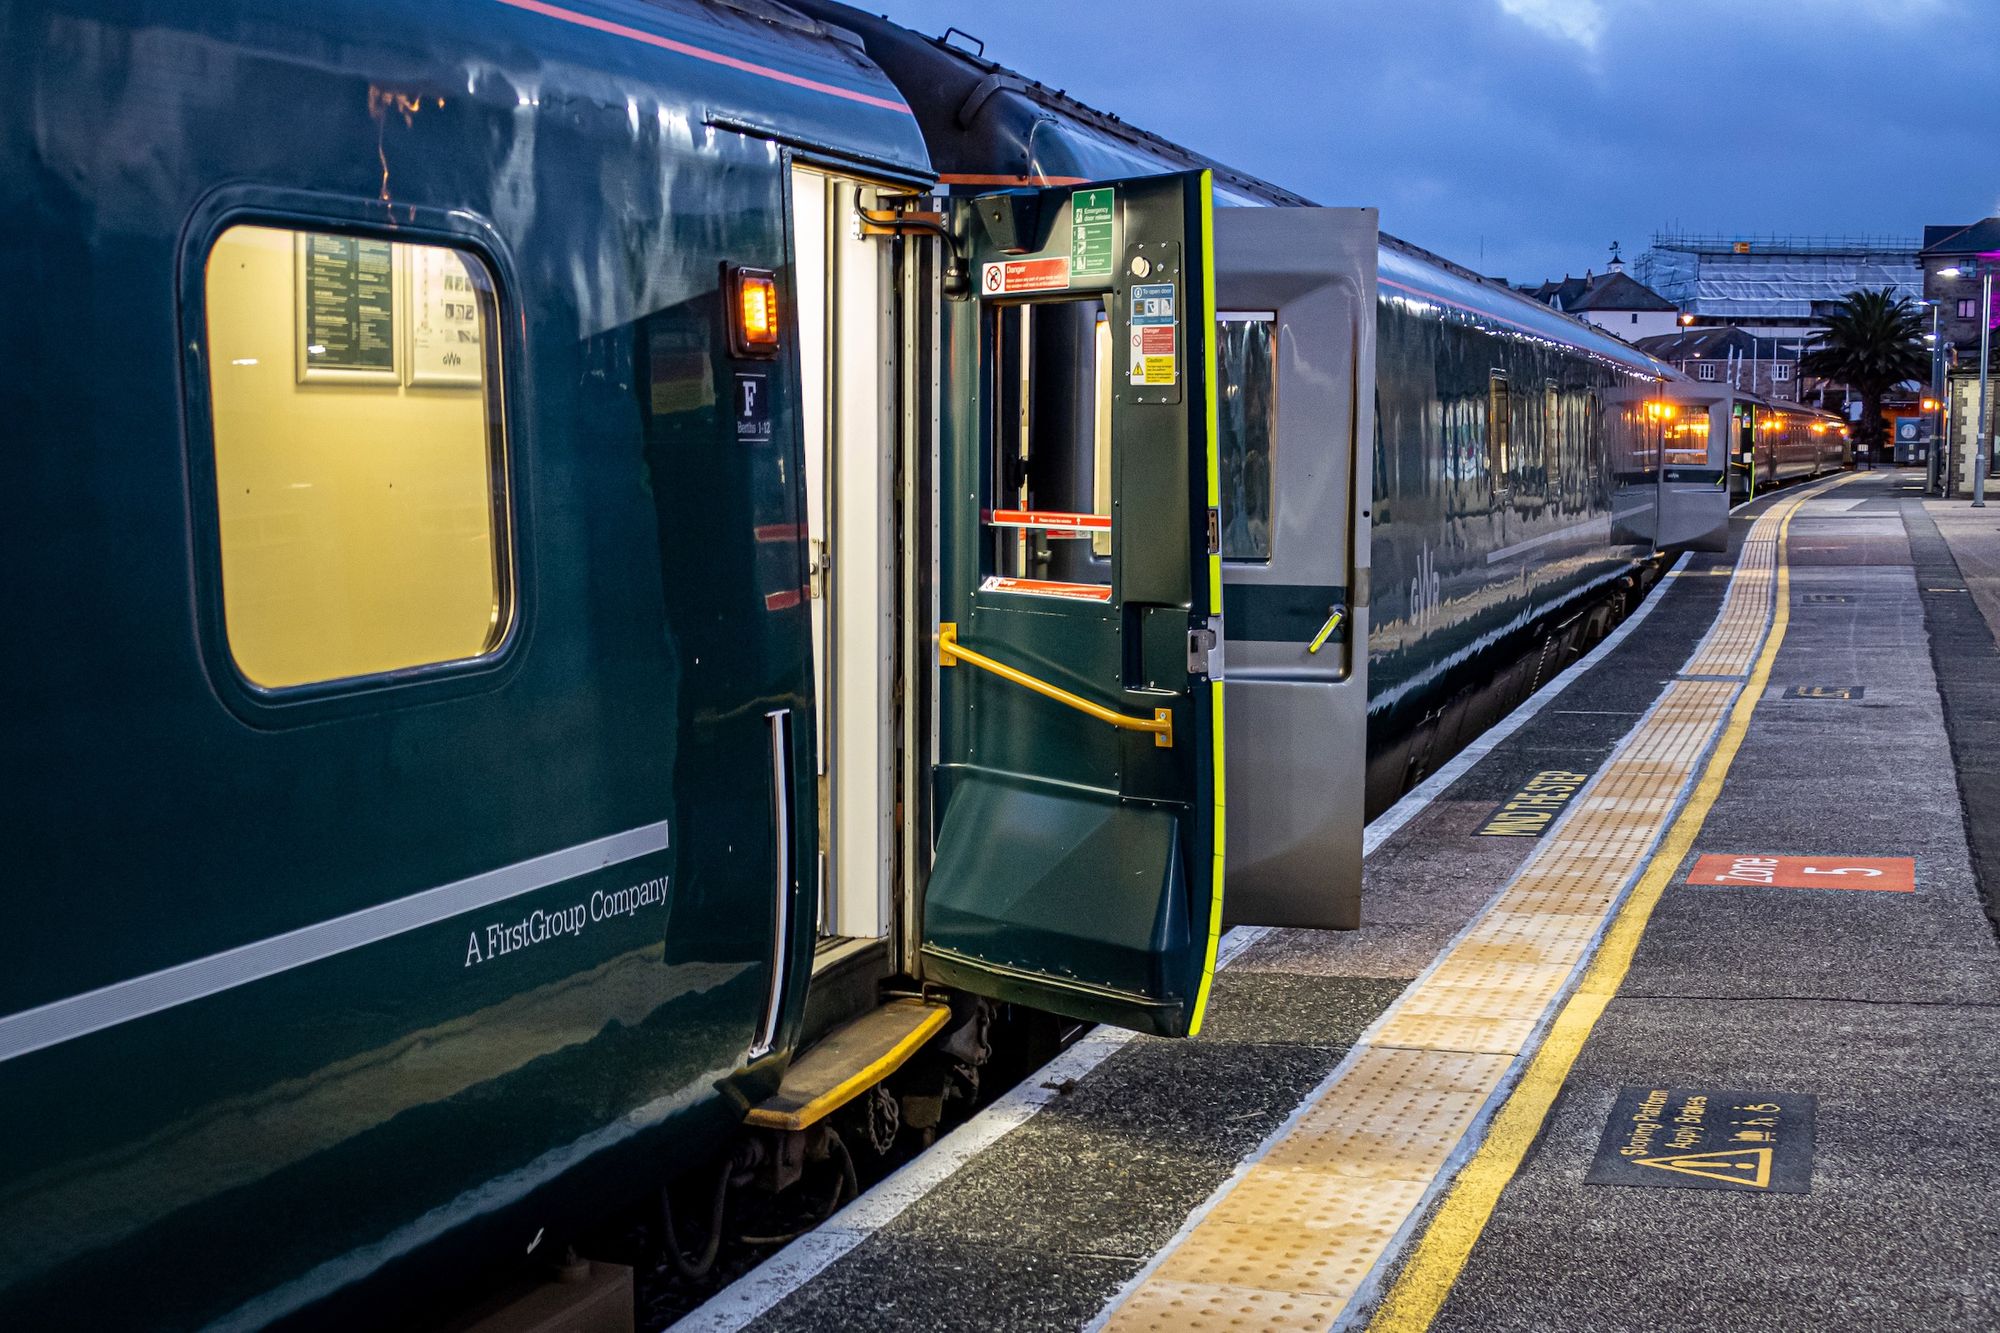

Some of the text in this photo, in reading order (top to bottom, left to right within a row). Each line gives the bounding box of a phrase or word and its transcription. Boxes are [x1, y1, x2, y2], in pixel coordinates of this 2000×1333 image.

[1084, 207, 1109, 215] Emergency
[1007, 266, 1026, 275] Danger
[1143, 327, 1160, 335] Danger
[442, 351, 462, 367] GWR
[742, 381, 757, 417] F
[737, 421, 771, 434] Berths 1-12
[1411, 538, 1440, 640] GWR
[1479, 770, 1588, 836] MIND THE STEP
[1714, 857, 1779, 884] Zone
[1803, 866, 1883, 877] 5
[464, 875, 669, 968] A FirstGroup Company
[1620, 1089, 1670, 1156] Sloping Platform
[1664, 1095, 1708, 1150] Apply Brakes
